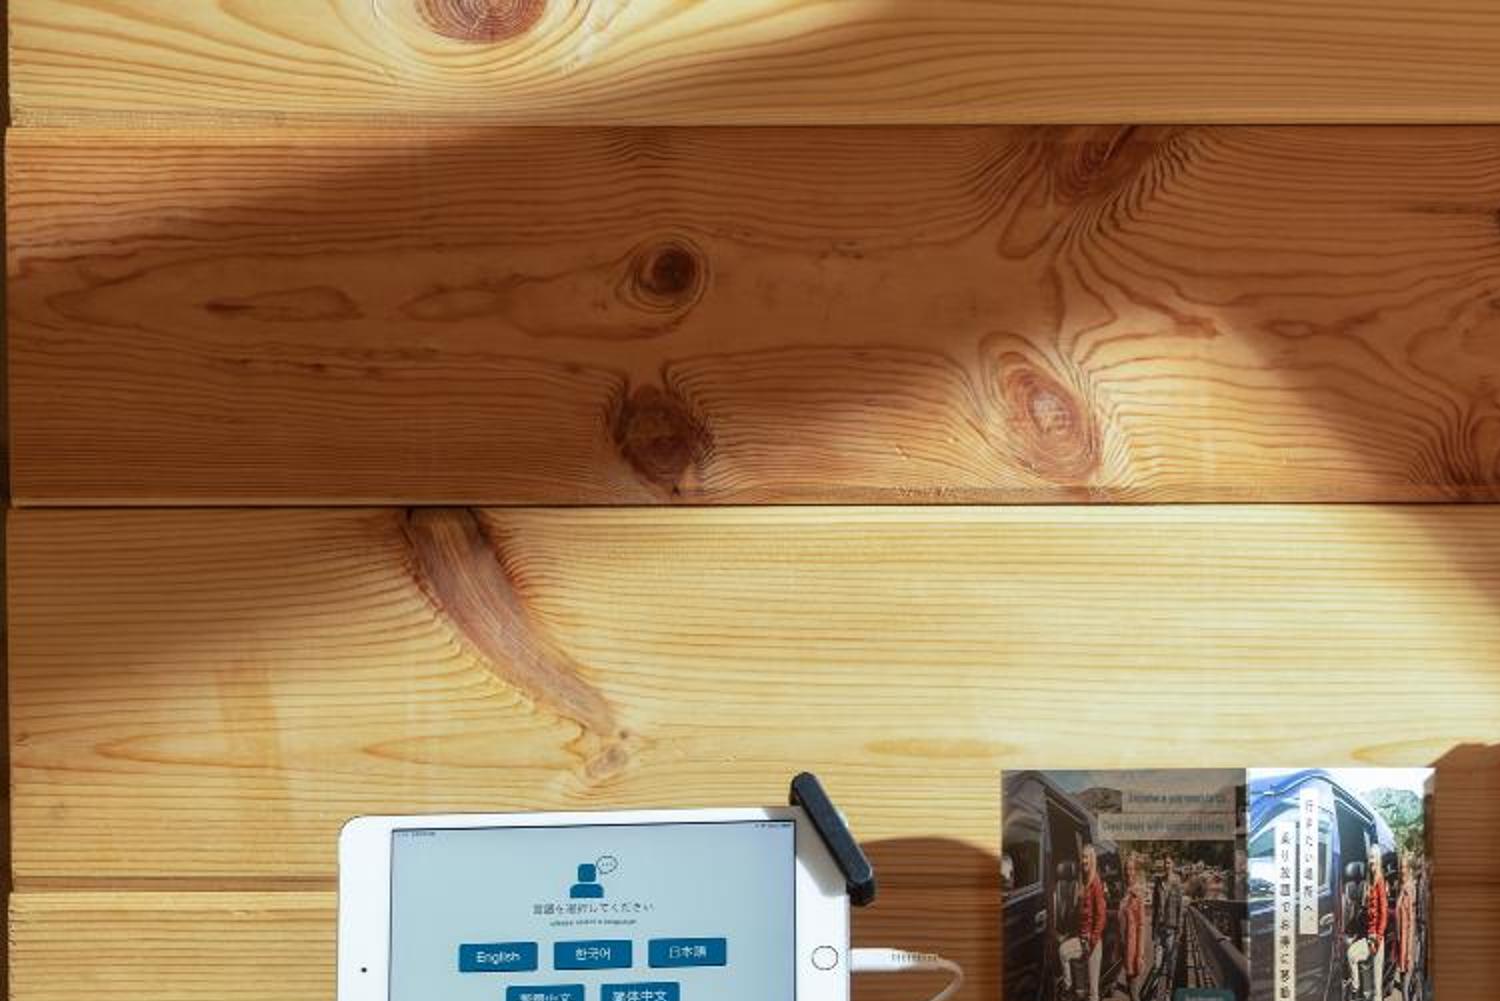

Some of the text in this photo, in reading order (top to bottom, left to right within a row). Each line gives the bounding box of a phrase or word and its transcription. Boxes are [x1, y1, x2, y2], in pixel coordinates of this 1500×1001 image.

[476, 949, 521, 965] English
[575, 946, 611, 961] 한국어
[669, 945, 707, 960] 日本語
